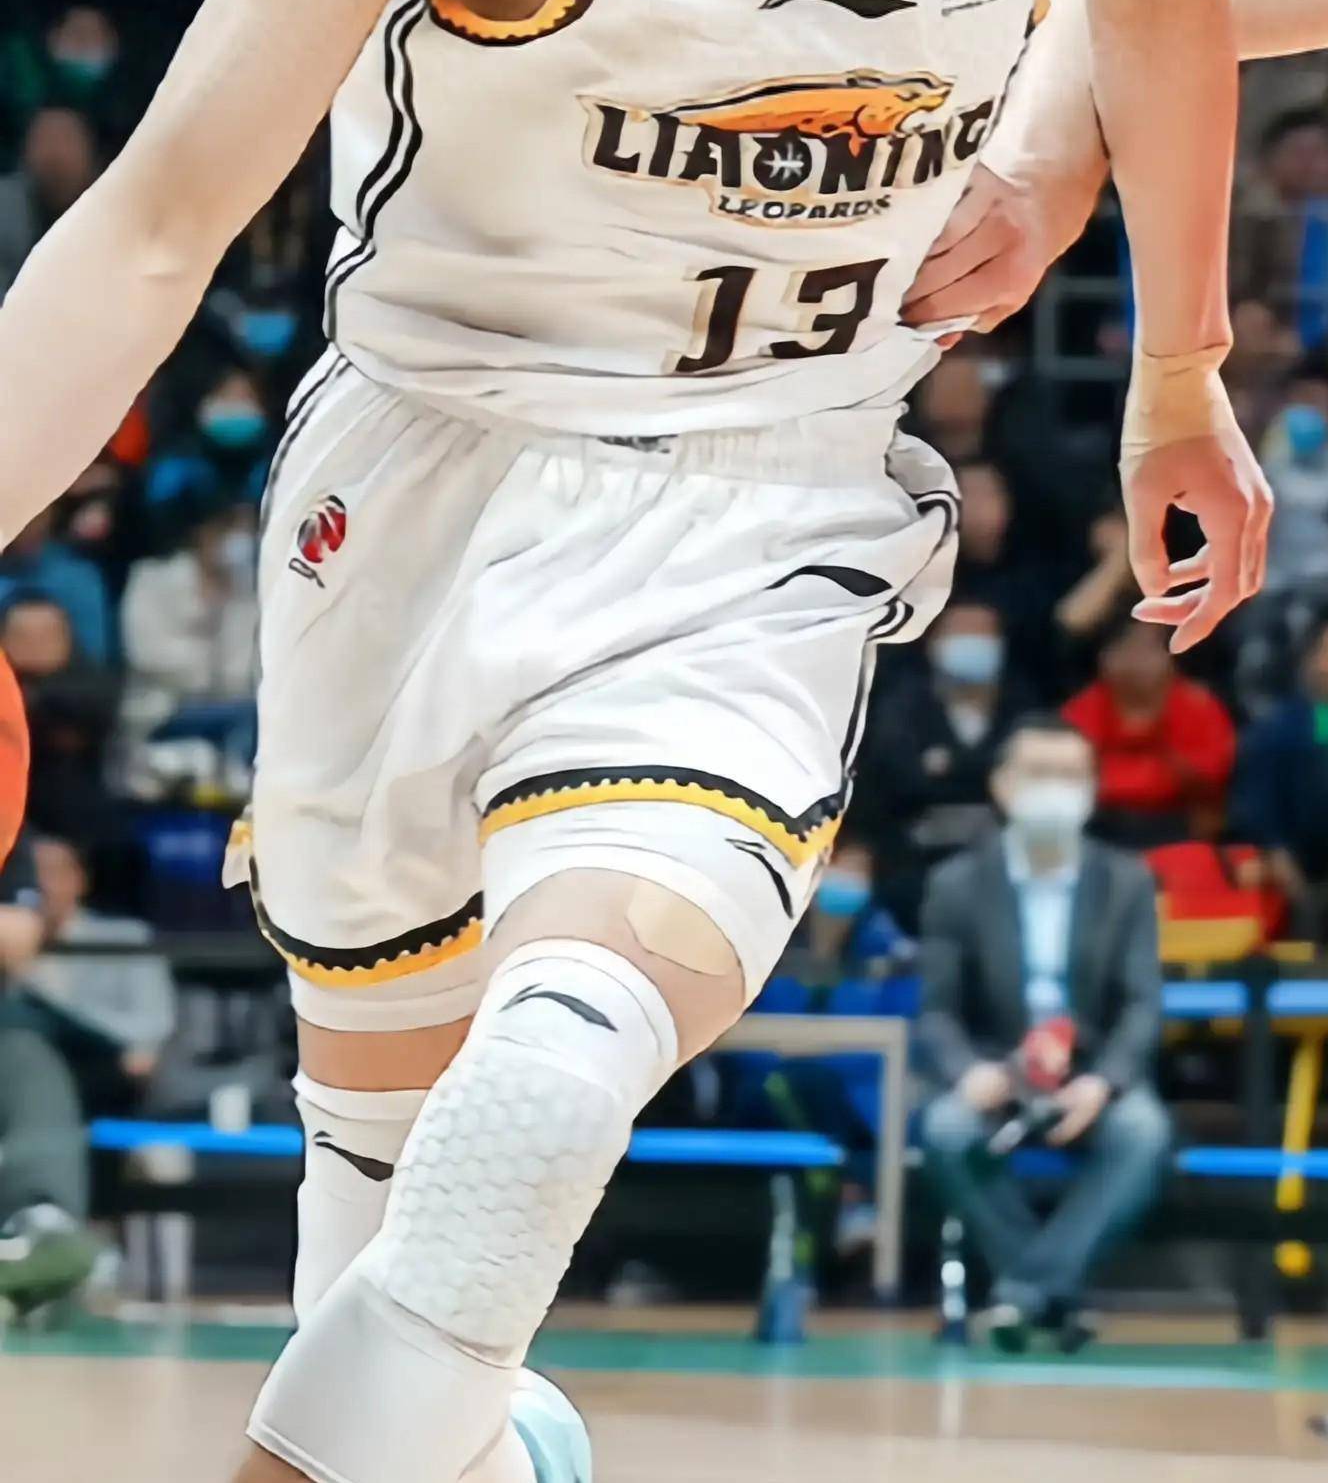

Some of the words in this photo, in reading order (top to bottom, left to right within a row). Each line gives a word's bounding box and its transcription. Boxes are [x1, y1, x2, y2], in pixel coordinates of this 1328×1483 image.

[592, 99, 996, 196] LIAONING
[718, 193, 892, 219] LEOPARDS
[672, 257, 891, 373] 13
